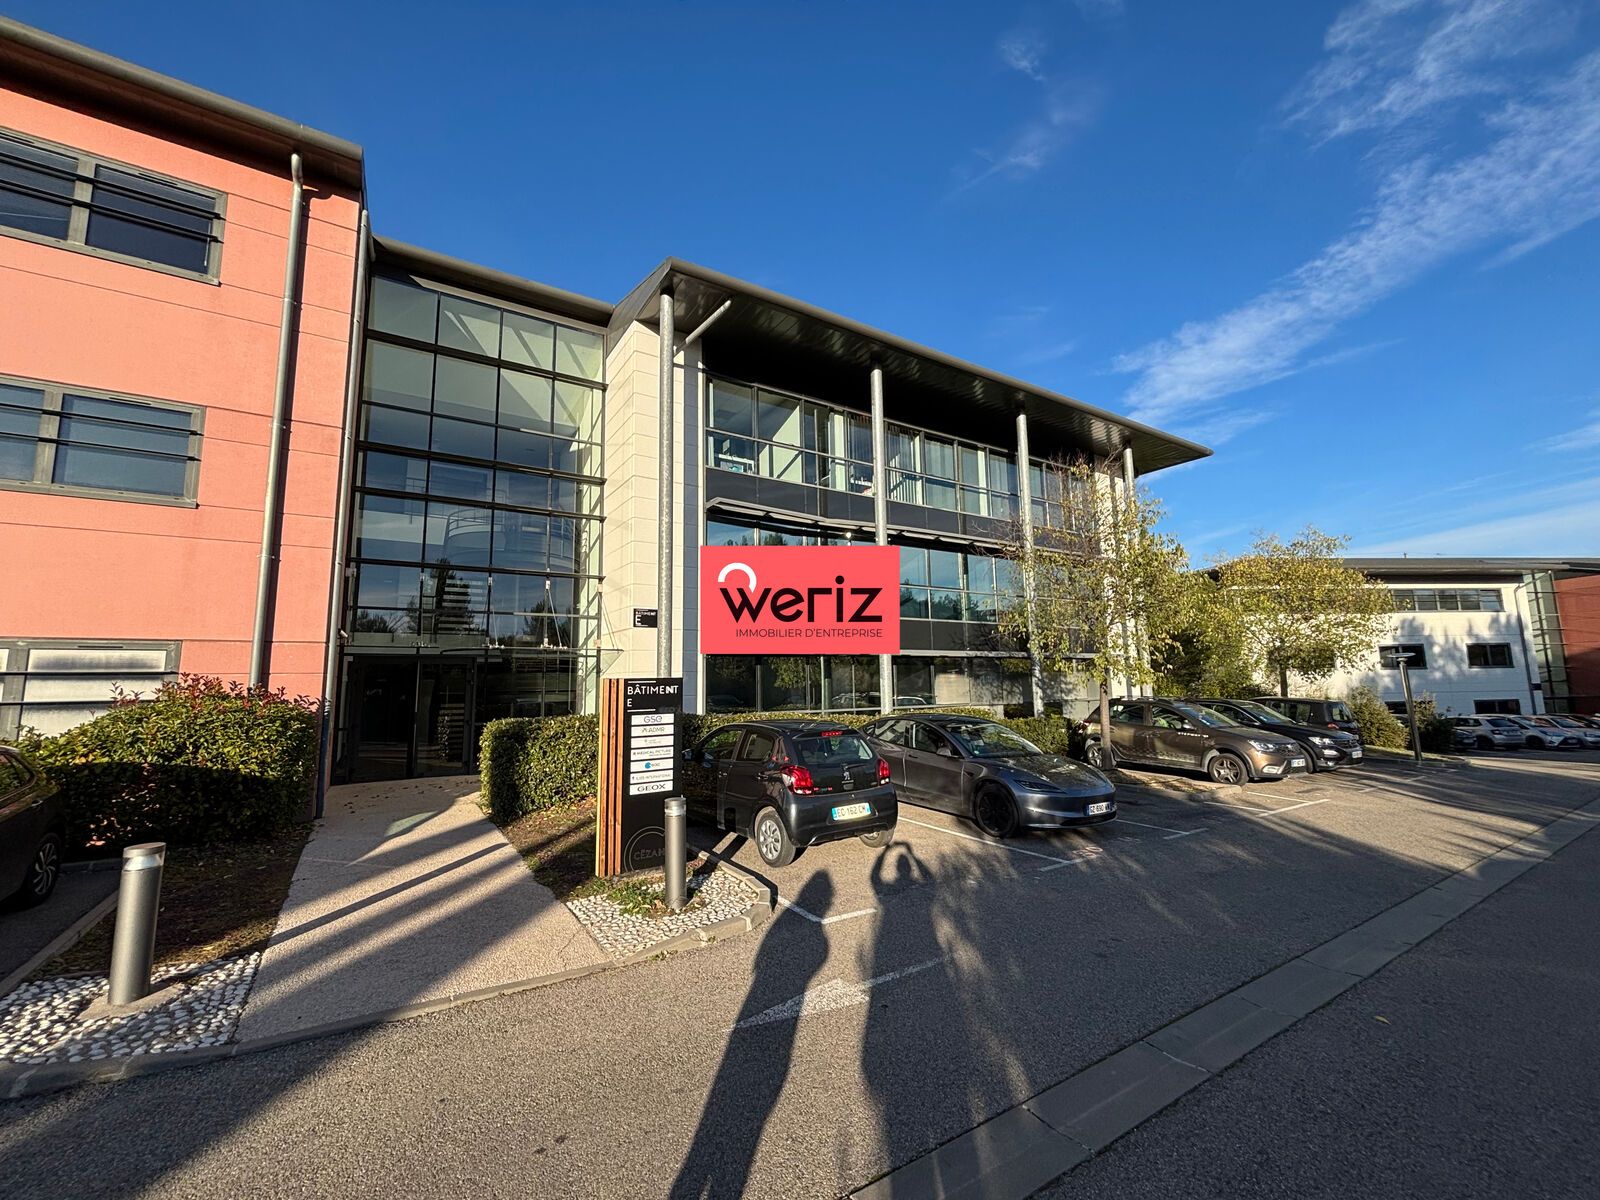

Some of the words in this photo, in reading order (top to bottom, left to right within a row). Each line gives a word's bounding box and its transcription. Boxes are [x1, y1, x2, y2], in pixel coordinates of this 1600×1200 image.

[627, 684, 679, 695] BÂTIMENT
[627, 698, 633, 707] E
[637, 783, 666, 792] GEOX
